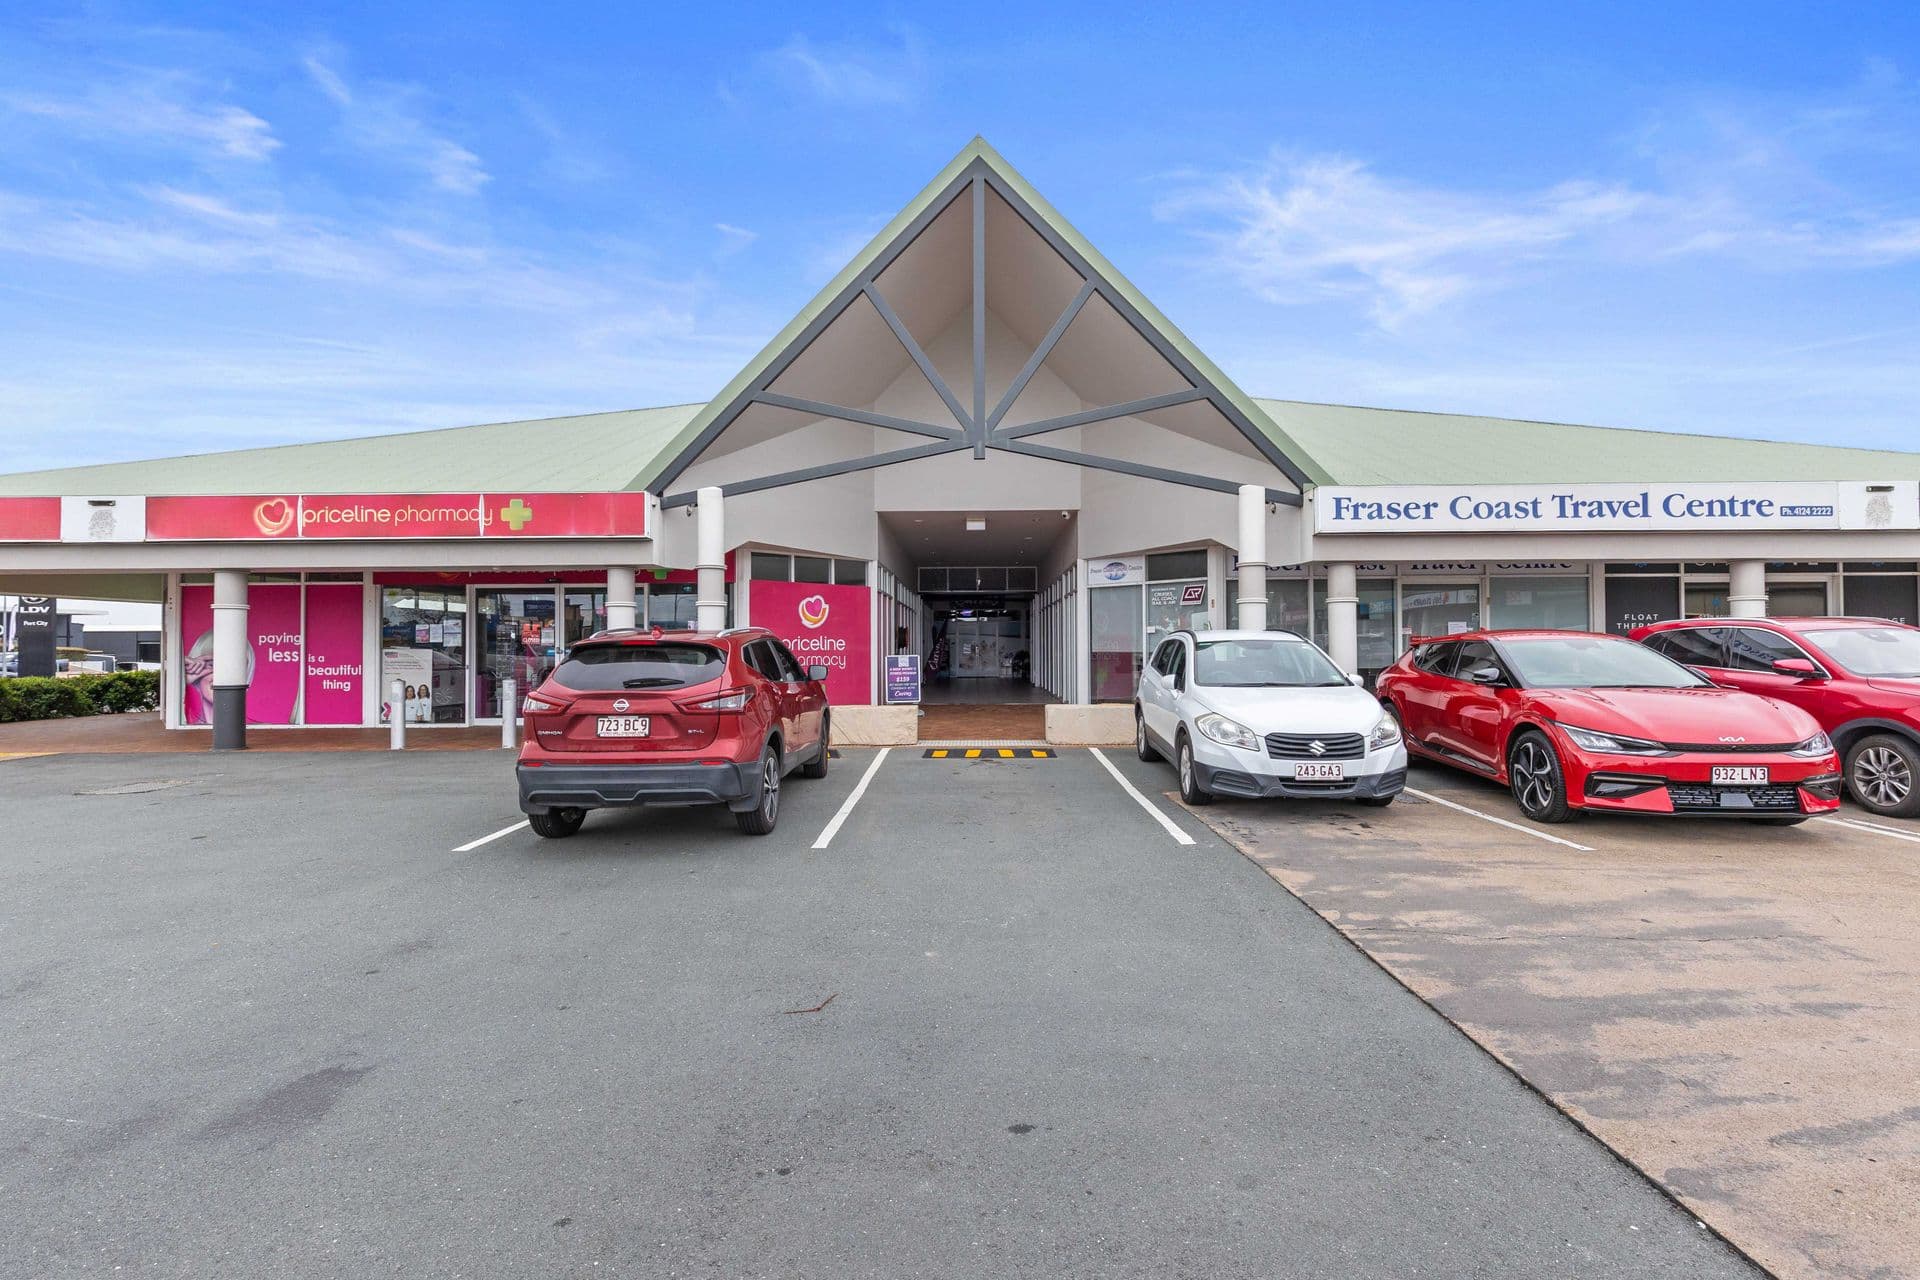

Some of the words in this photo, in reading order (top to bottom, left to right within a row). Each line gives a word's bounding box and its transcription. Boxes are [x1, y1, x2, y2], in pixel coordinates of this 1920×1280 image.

[1332, 496, 1439, 520] Fraser
[1449, 495, 1542, 520] Coast
[1551, 492, 1652, 519] Travel
[1662, 493, 1774, 518] Centre
[1812, 507, 1831, 515] 2222
[302, 505, 391, 527] priceline
[258, 632, 301, 646] paying
[268, 648, 300, 662] less
[308, 653, 317, 662] is
[308, 664, 362, 676] beautiful
[323, 679, 351, 692] thing
